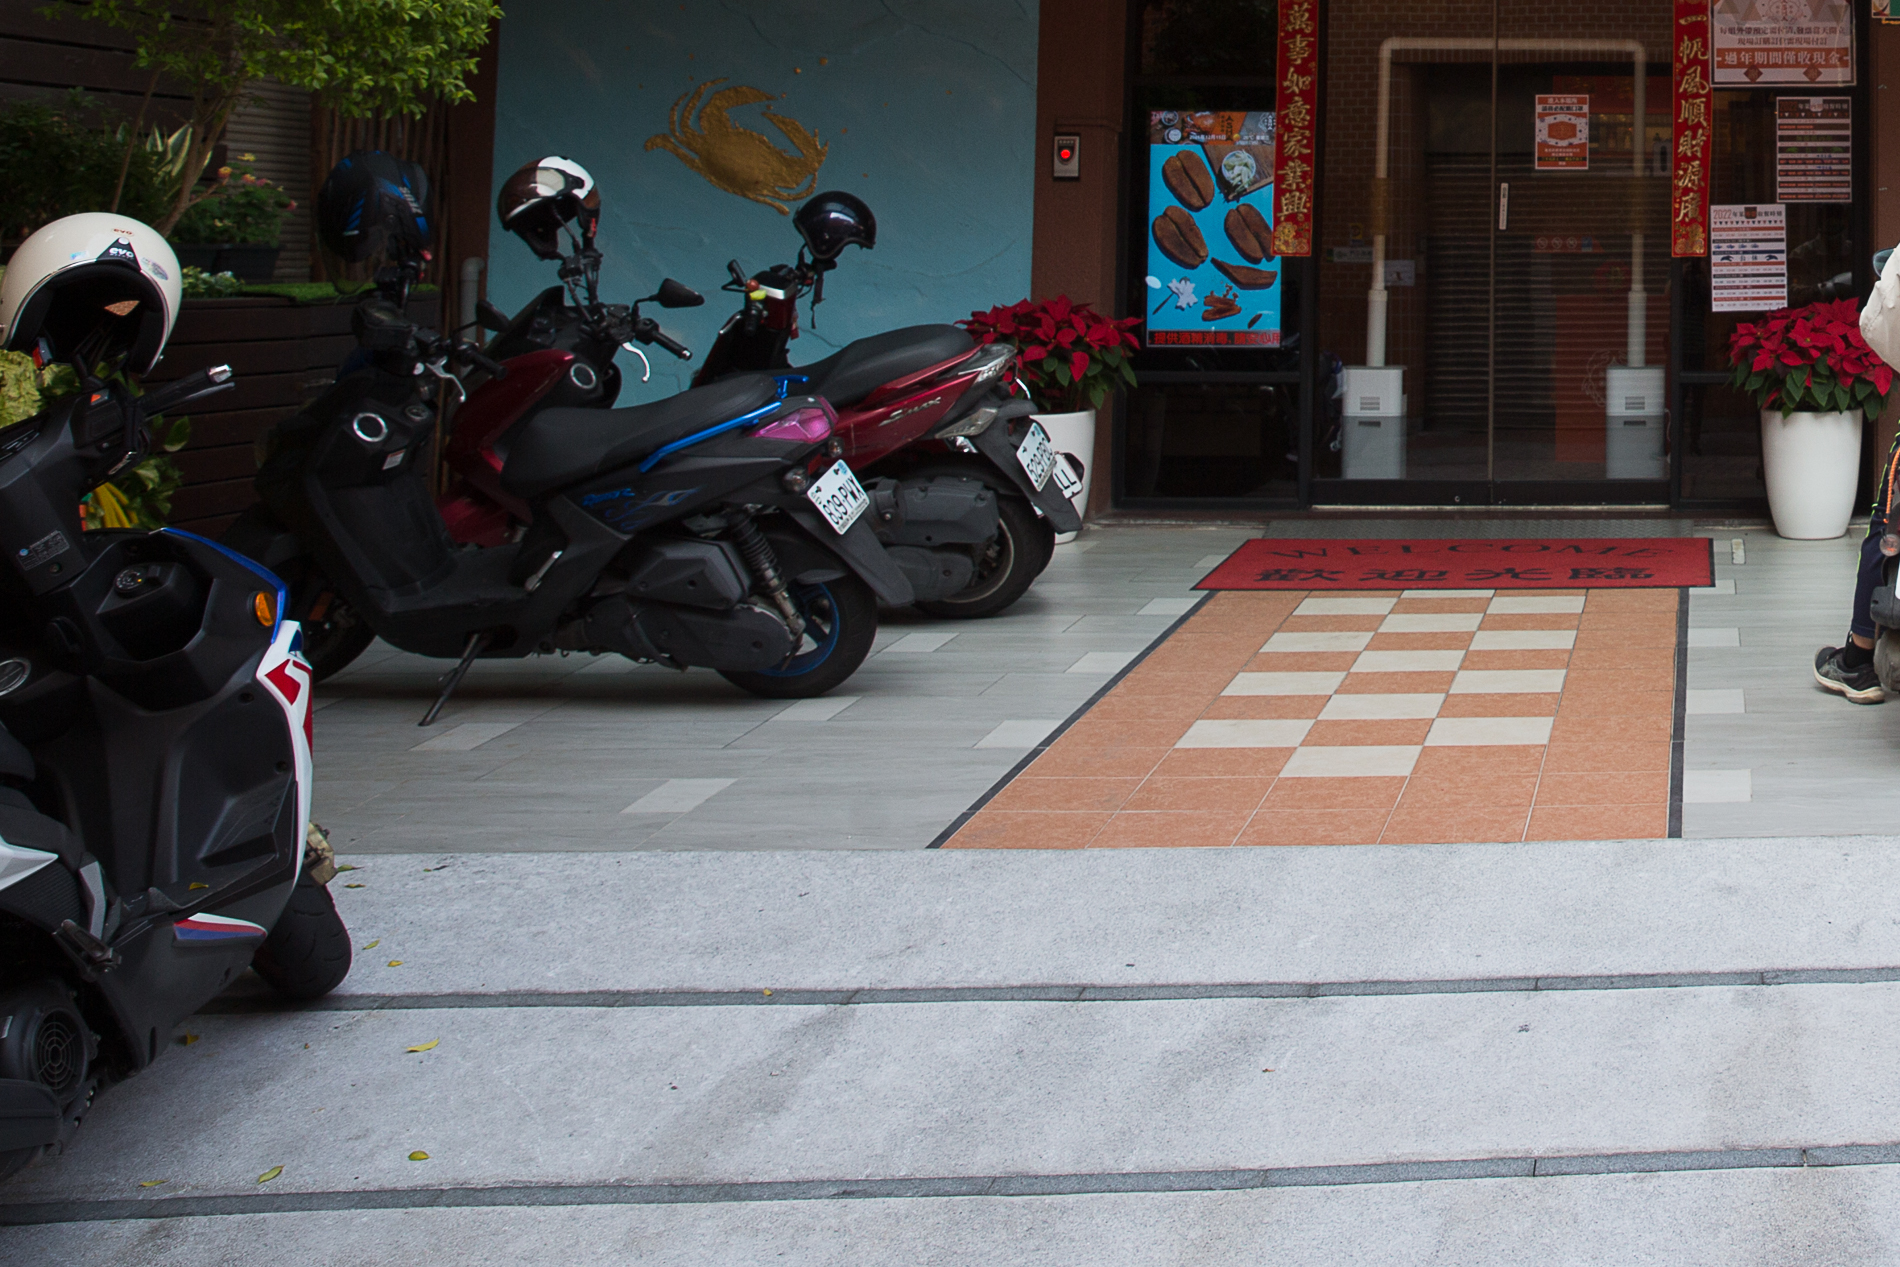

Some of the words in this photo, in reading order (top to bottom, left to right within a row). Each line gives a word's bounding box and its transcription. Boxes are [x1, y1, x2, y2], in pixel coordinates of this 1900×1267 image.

[1277, 1, 1315, 222] 萬事如意家業興
[109, 247, 135, 258] evo
[1264, 543, 1676, 560] WELCOME
[1252, 566, 1656, 584] 歡迎光臨
